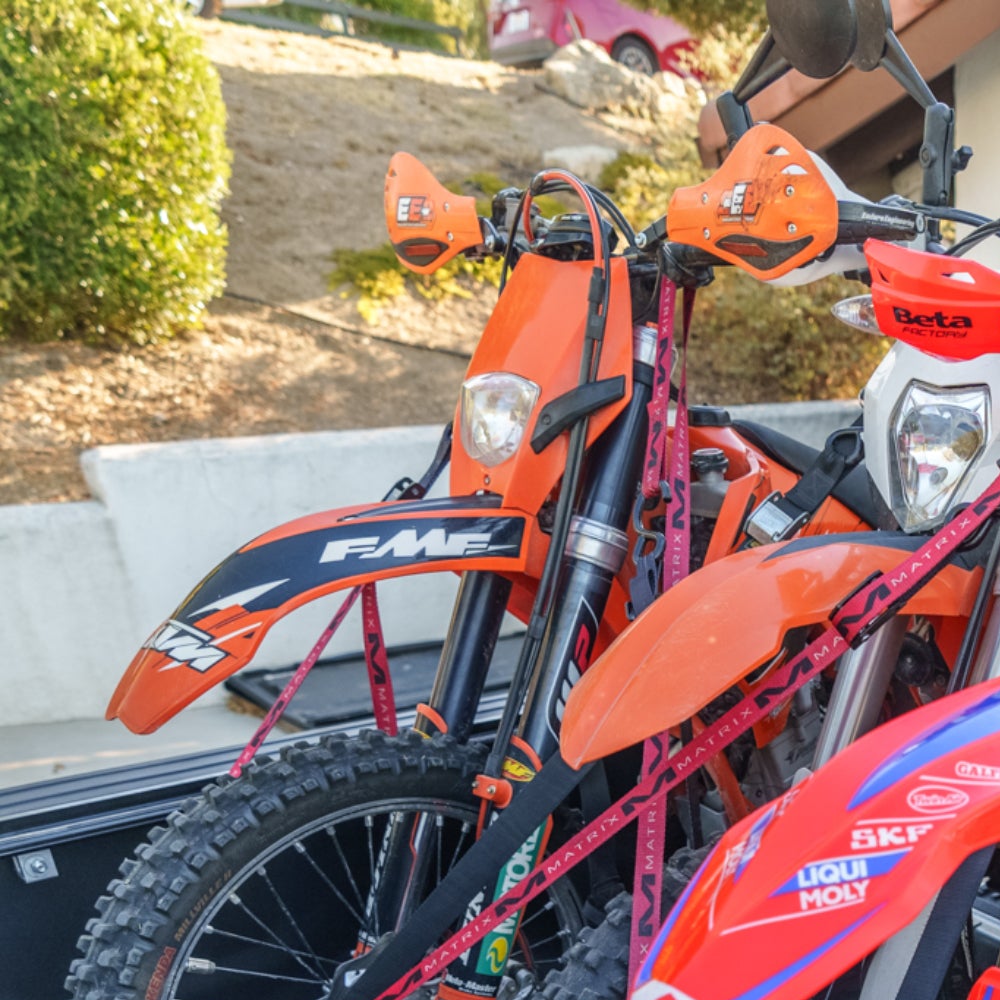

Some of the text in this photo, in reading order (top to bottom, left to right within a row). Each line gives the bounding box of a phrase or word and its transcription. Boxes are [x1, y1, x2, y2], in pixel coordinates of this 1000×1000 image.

[892, 306, 973, 329] Beta
[319, 528, 492, 563] FMF
[890, 517, 971, 588] MATRIX
[376, 687, 392, 737] MATR
[676, 706, 753, 771] MATRIX
[547, 813, 620, 875] MATRIX
[644, 802, 658, 870] MATR
[851, 824, 933, 849] SKF
[797, 860, 868, 887] LIQUI
[800, 880, 870, 911] MOLY
[423, 916, 493, 973] MATRIX
